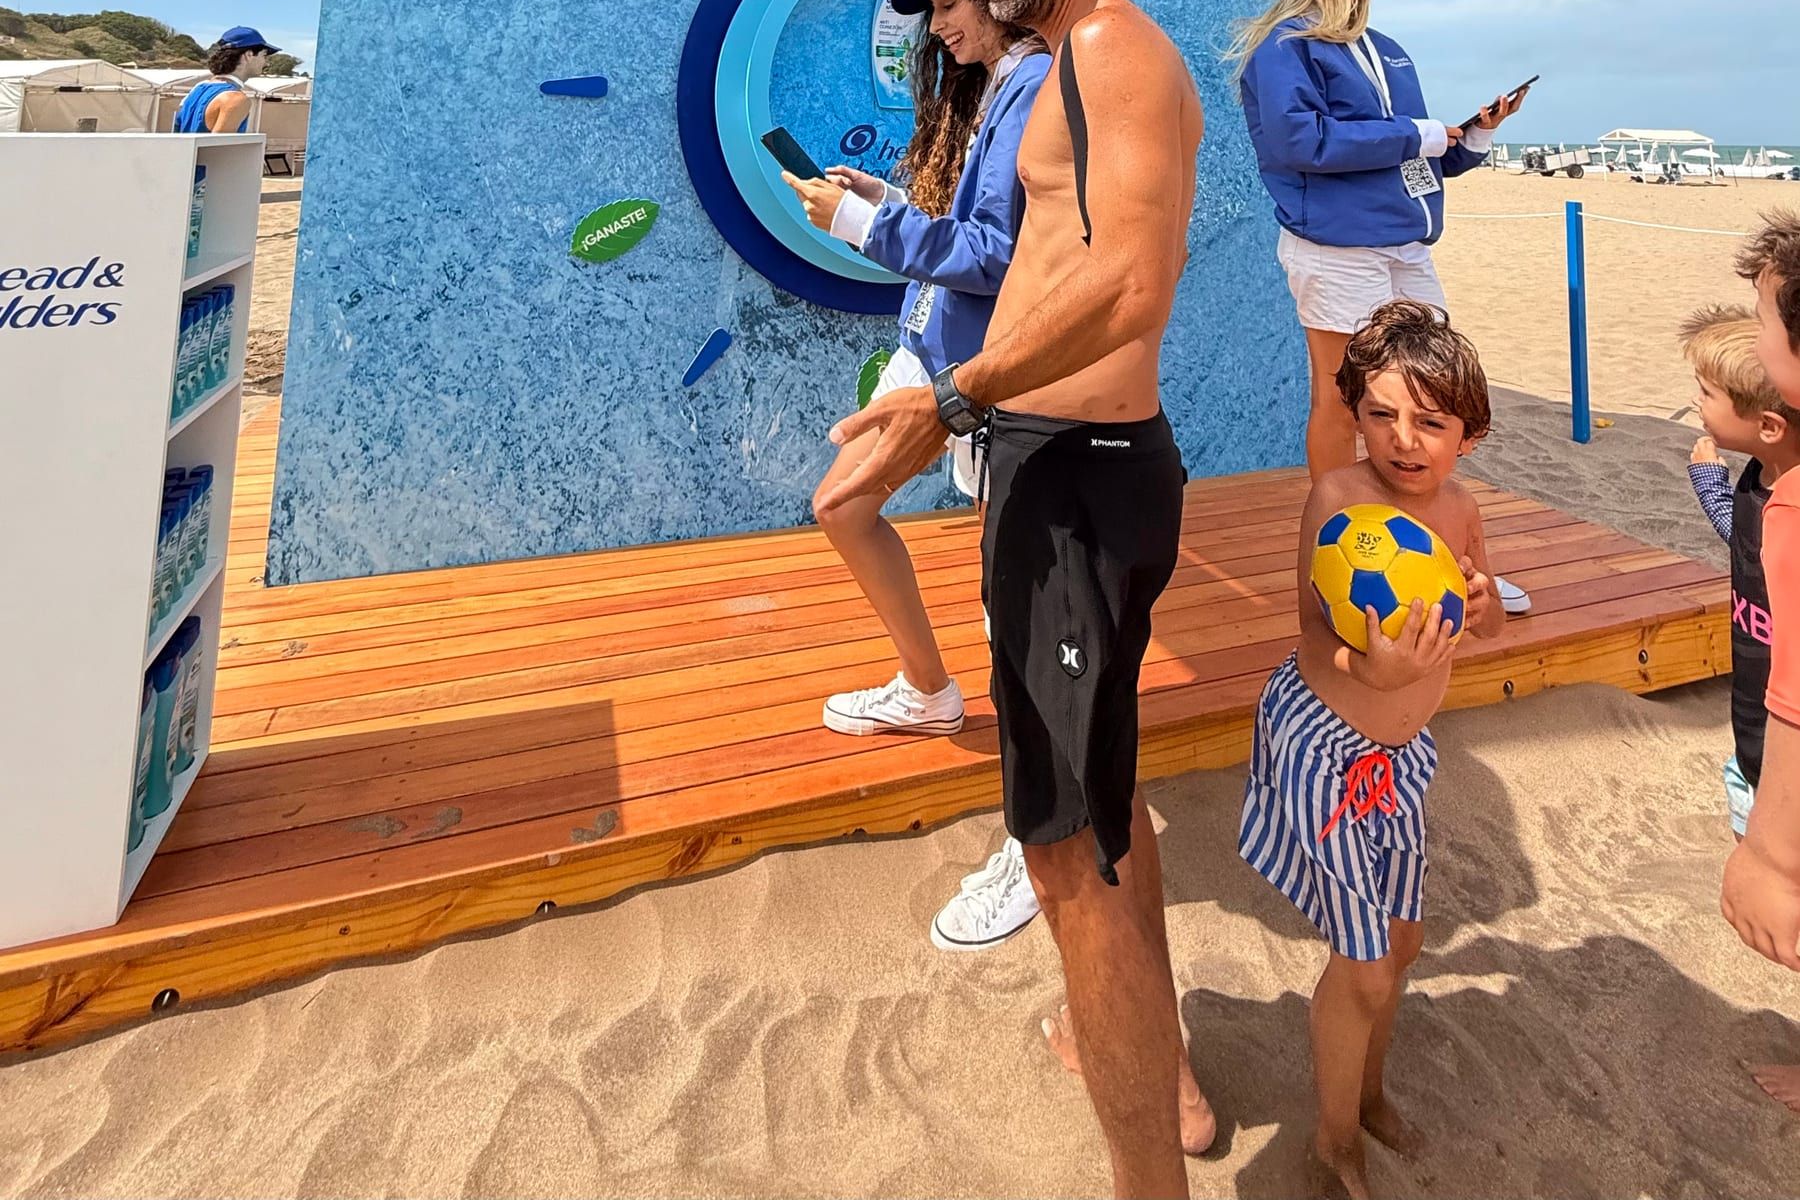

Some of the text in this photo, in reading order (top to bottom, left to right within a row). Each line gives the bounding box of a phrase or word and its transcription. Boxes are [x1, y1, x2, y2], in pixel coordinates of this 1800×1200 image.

[877, 138, 909, 160] he
[581, 207, 647, 251] ¡GANASTE!
[0, 256, 101, 291] ead
[0, 294, 122, 328] lders
[1097, 439, 1130, 447] PHANTOM
